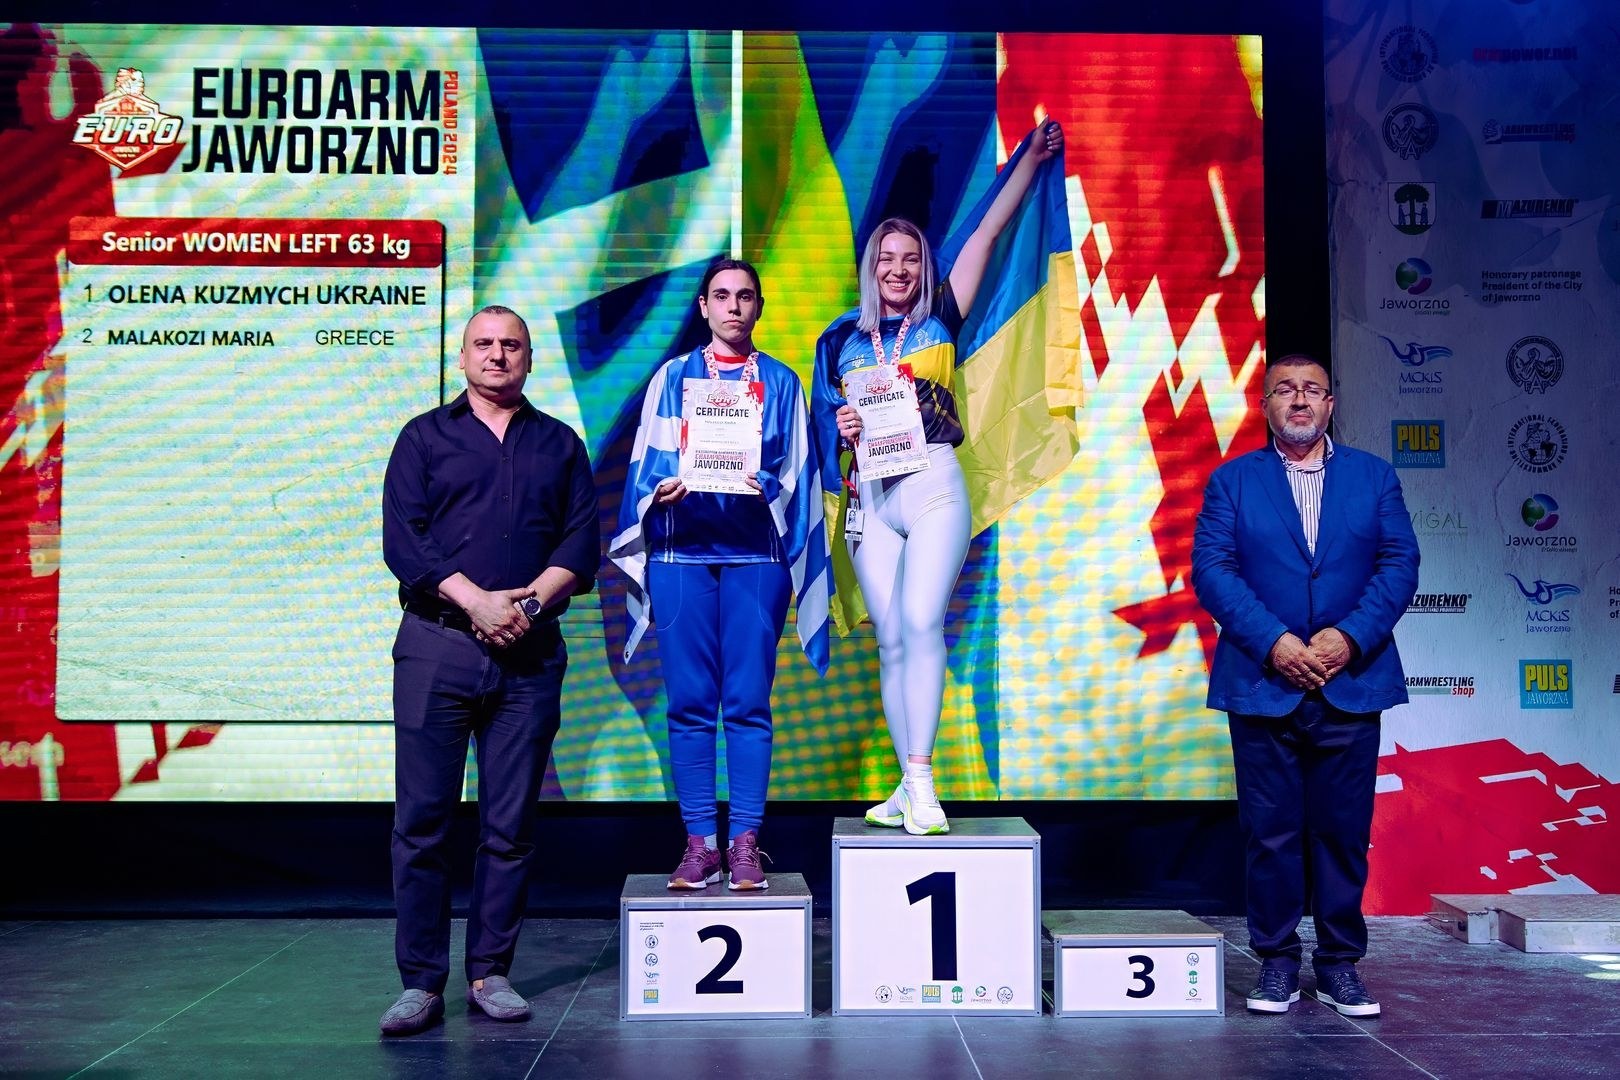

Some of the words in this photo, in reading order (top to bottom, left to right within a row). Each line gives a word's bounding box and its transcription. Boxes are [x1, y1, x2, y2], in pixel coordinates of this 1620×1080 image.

[192, 67, 442, 121] EUROARM
[443, 71, 459, 129] POLAND
[72, 117, 183, 145] EURO
[182, 125, 440, 175] JAWORZNO
[443, 133, 459, 175] 2024
[102, 232, 176, 253] Senior
[183, 233, 281, 254] WOMEN
[289, 234, 341, 254] LEFT
[348, 234, 375, 255] 63
[383, 234, 411, 260] kg
[1481, 270, 1528, 281] Honorary
[1531, 270, 1582, 280] patronage
[1481, 281, 1530, 291] President
[1532, 281, 1543, 290] of
[1544, 281, 1561, 290] the
[1564, 281, 1583, 292] City
[85, 284, 93, 302] 1
[109, 285, 186, 304] OLENA
[195, 285, 309, 305] KUZMYCH
[317, 286, 426, 306] UKRAINE
[1482, 292, 1493, 302] of
[1493, 293, 1541, 303] Jaworzno
[1379, 298, 1450, 310] Jaworzno
[82, 328, 92, 344] 2
[108, 330, 205, 346] MALAKOZI
[212, 331, 275, 347] MARIA
[315, 330, 395, 347] GREECE
[1399, 385, 1443, 394] Jaworzno
[858, 391, 905, 407] CERTIFICATE
[695, 406, 750, 418] CERTIFICATE
[1396, 424, 1440, 451] PULS
[868, 441, 912, 458] JAWORZNO
[693, 459, 744, 471] JAWORZNO
[1505, 534, 1577, 547] Jaworzno
[1408, 593, 1468, 607] ZURENKO
[1525, 623, 1571, 634] Jaworzno
[1405, 676, 1474, 687] ARMWRESTLING
[1525, 664, 1568, 691] PULS
[1452, 684, 1475, 698] shop
[1526, 692, 1569, 705] JAWORZNA
[905, 871, 958, 981] 1
[695, 924, 744, 994] 2
[1125, 954, 1156, 999] 3
